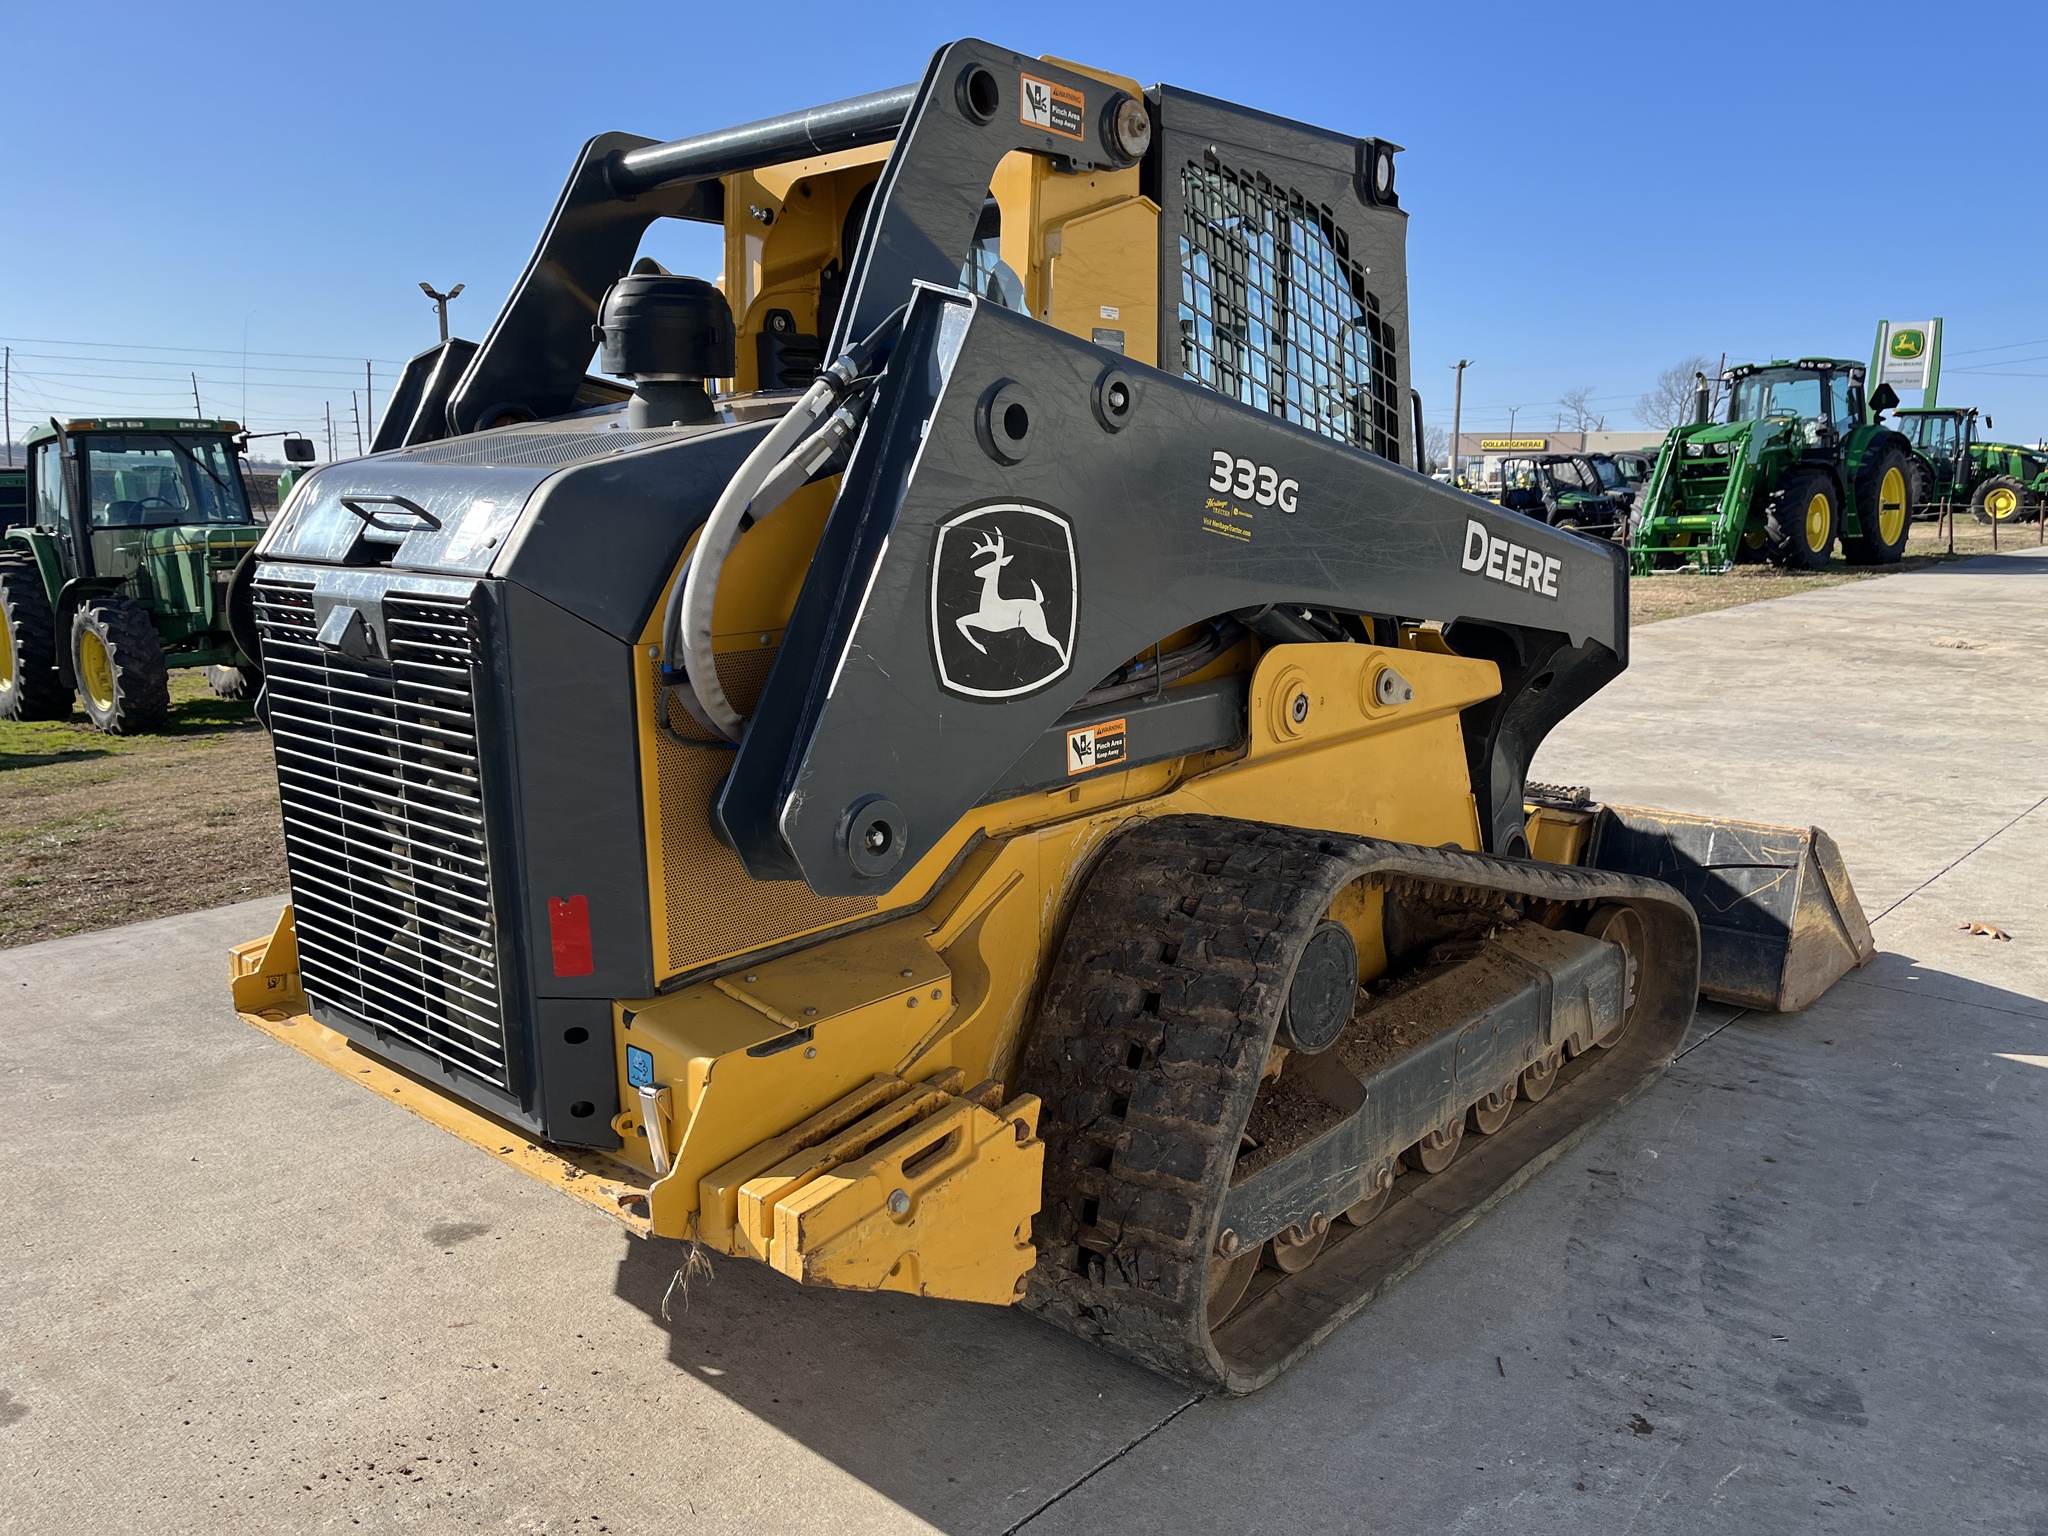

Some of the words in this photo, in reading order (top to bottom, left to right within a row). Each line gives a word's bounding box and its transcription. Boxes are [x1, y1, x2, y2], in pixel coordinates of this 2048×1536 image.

[1052, 105, 1067, 117] Pinch
[1068, 110, 1080, 121] Area
[1051, 116, 1063, 126] Keep
[1064, 120, 1077, 131] Away
[1209, 451, 1299, 513] 333G
[1462, 519, 1562, 598] DEERE
[1096, 742, 1110, 751] Pinch
[1111, 739, 1122, 747] Area
